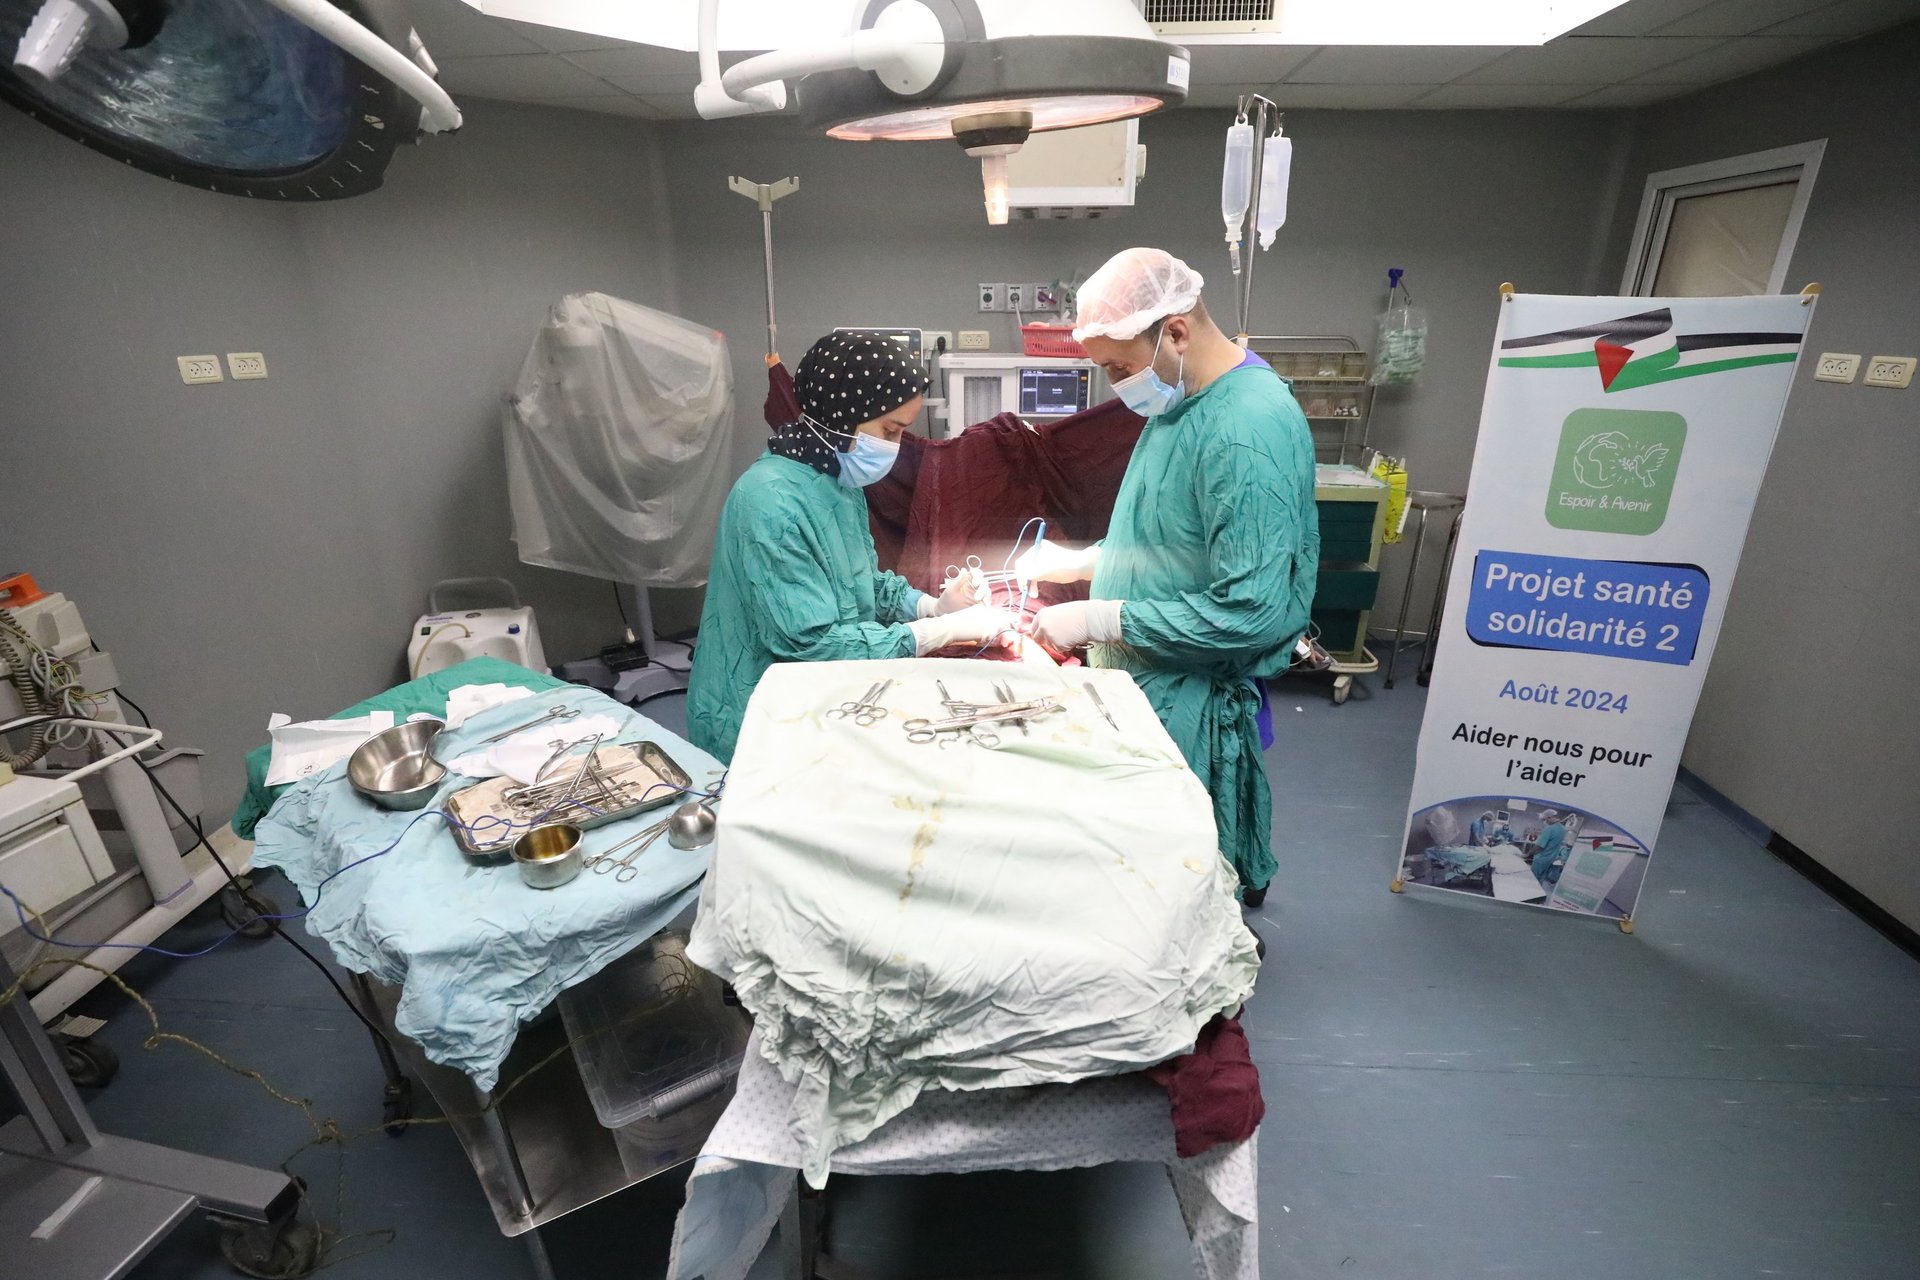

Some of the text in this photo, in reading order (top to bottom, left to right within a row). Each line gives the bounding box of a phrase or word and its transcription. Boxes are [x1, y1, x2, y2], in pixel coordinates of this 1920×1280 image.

[1559, 491, 1652, 512] Espoir & Avenir
[1485, 563, 1693, 609] Projet santé
[1488, 608, 1680, 651] solidarité 2
[1499, 679, 1629, 714] Août 2024
[1451, 722, 1653, 768] Aider nous pour
[1506, 759, 1586, 788] l’aider
